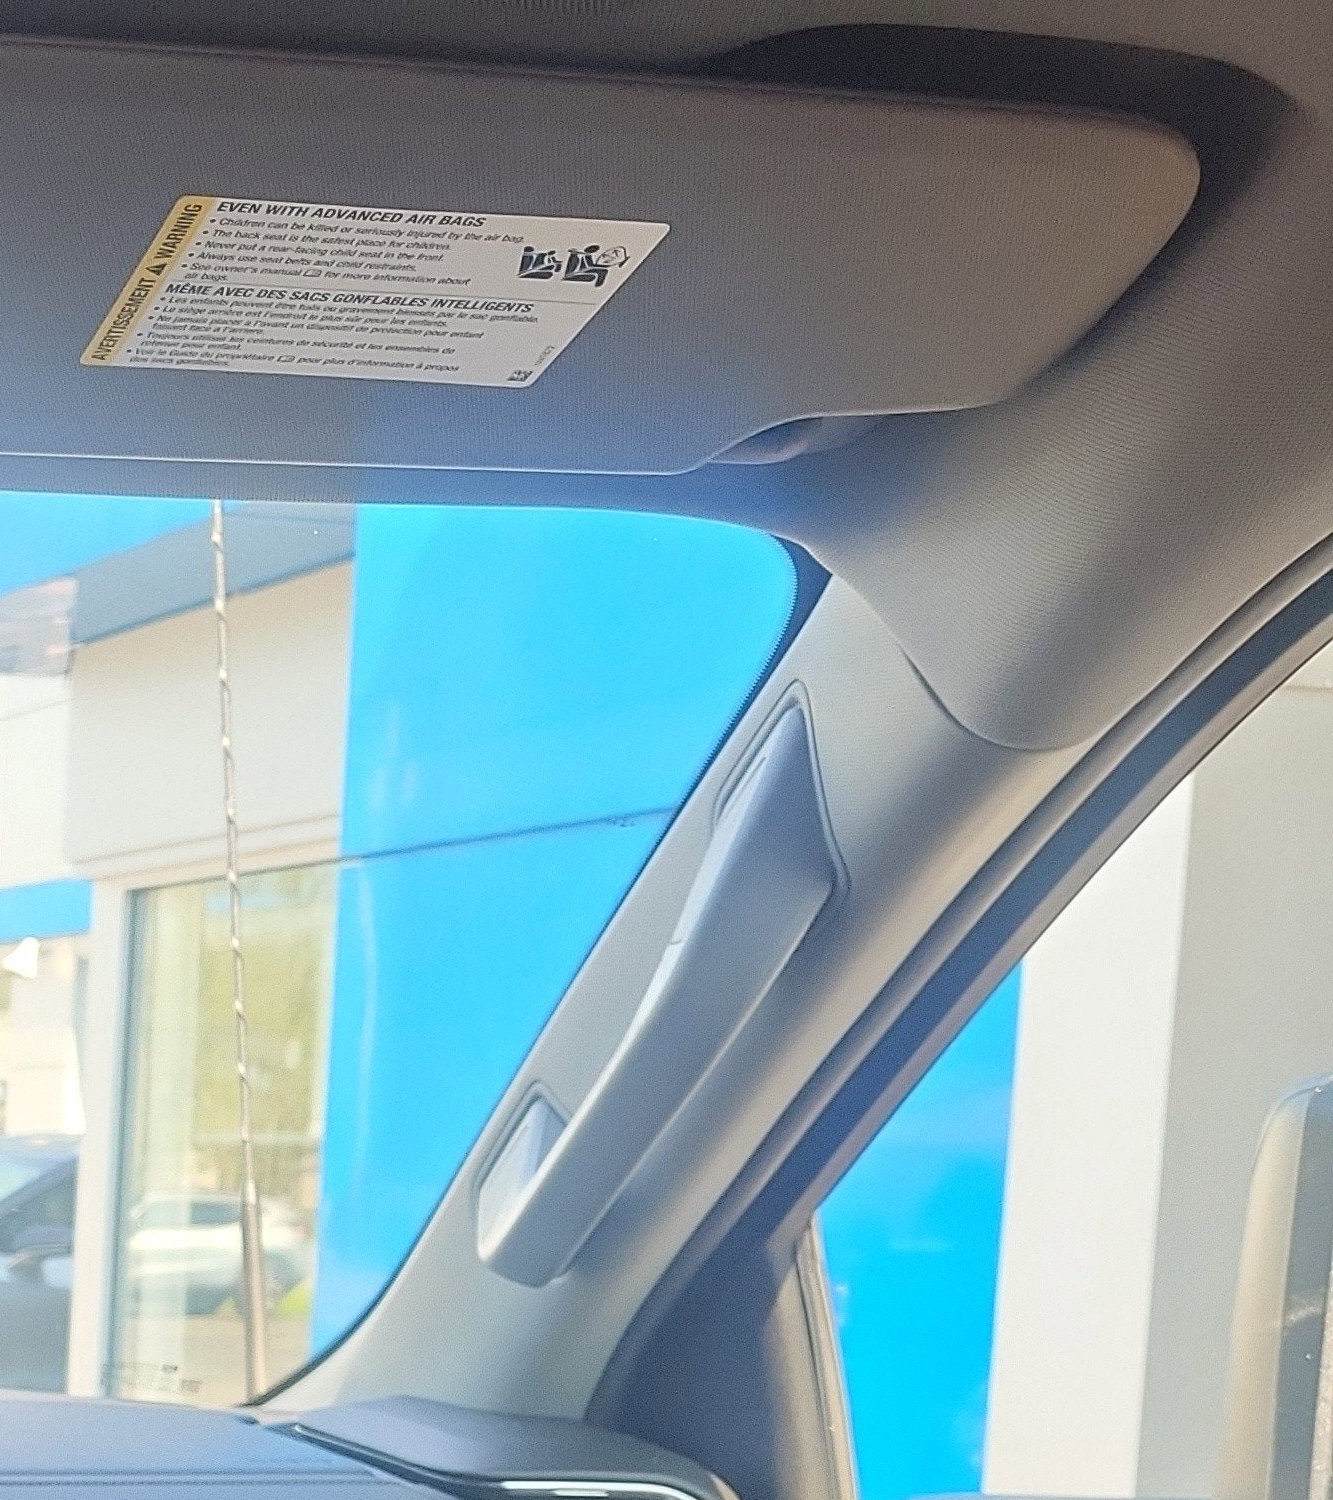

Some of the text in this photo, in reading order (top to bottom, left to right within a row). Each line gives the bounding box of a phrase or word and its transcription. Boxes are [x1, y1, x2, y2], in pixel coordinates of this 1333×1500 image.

[217, 201, 487, 228] EVEN WITH ADVANCED AIR BAGS
[155, 203, 202, 259] WARNING
[212, 229, 232, 238] The
[234, 230, 260, 240] back
[262, 233, 287, 242] seat
[288, 234, 299, 242] is
[301, 235, 319, 244] the
[320, 236, 354, 246] safest
[355, 238, 386, 248] place
[388, 240, 405, 248] for
[219, 217, 266, 228] Children
[268, 221, 288, 230] can
[290, 221, 305, 230] be
[307, 223, 339, 233] killed
[340, 226, 352, 234] or
[354, 227, 405, 238] seriously
[406, 229, 447, 240] injured
[447, 231, 462, 241] by
[464, 232, 483, 241] the
[484, 234, 502, 242] air
[197, 251, 237, 262] Always
[259, 255, 283, 264] seat
[284, 257, 312, 266] belts
[313, 259, 334, 267] and
[335, 260, 364, 269] child
[204, 240, 238, 249] Never
[237, 243, 257, 252] put
[329, 247, 357, 257] child
[357, 251, 383, 259] seat
[383, 251, 395, 259] in
[396, 252, 415, 260] the
[191, 262, 211, 271] See
[260, 267, 302, 276] manual
[324, 271, 340, 279] for
[438, 277, 472, 286] about
[165, 283, 535, 313] MÊME AVEC DES SACS GONFLABLES INTELLIGENTS
[91, 277, 156, 361] AVERTISSEMENT
